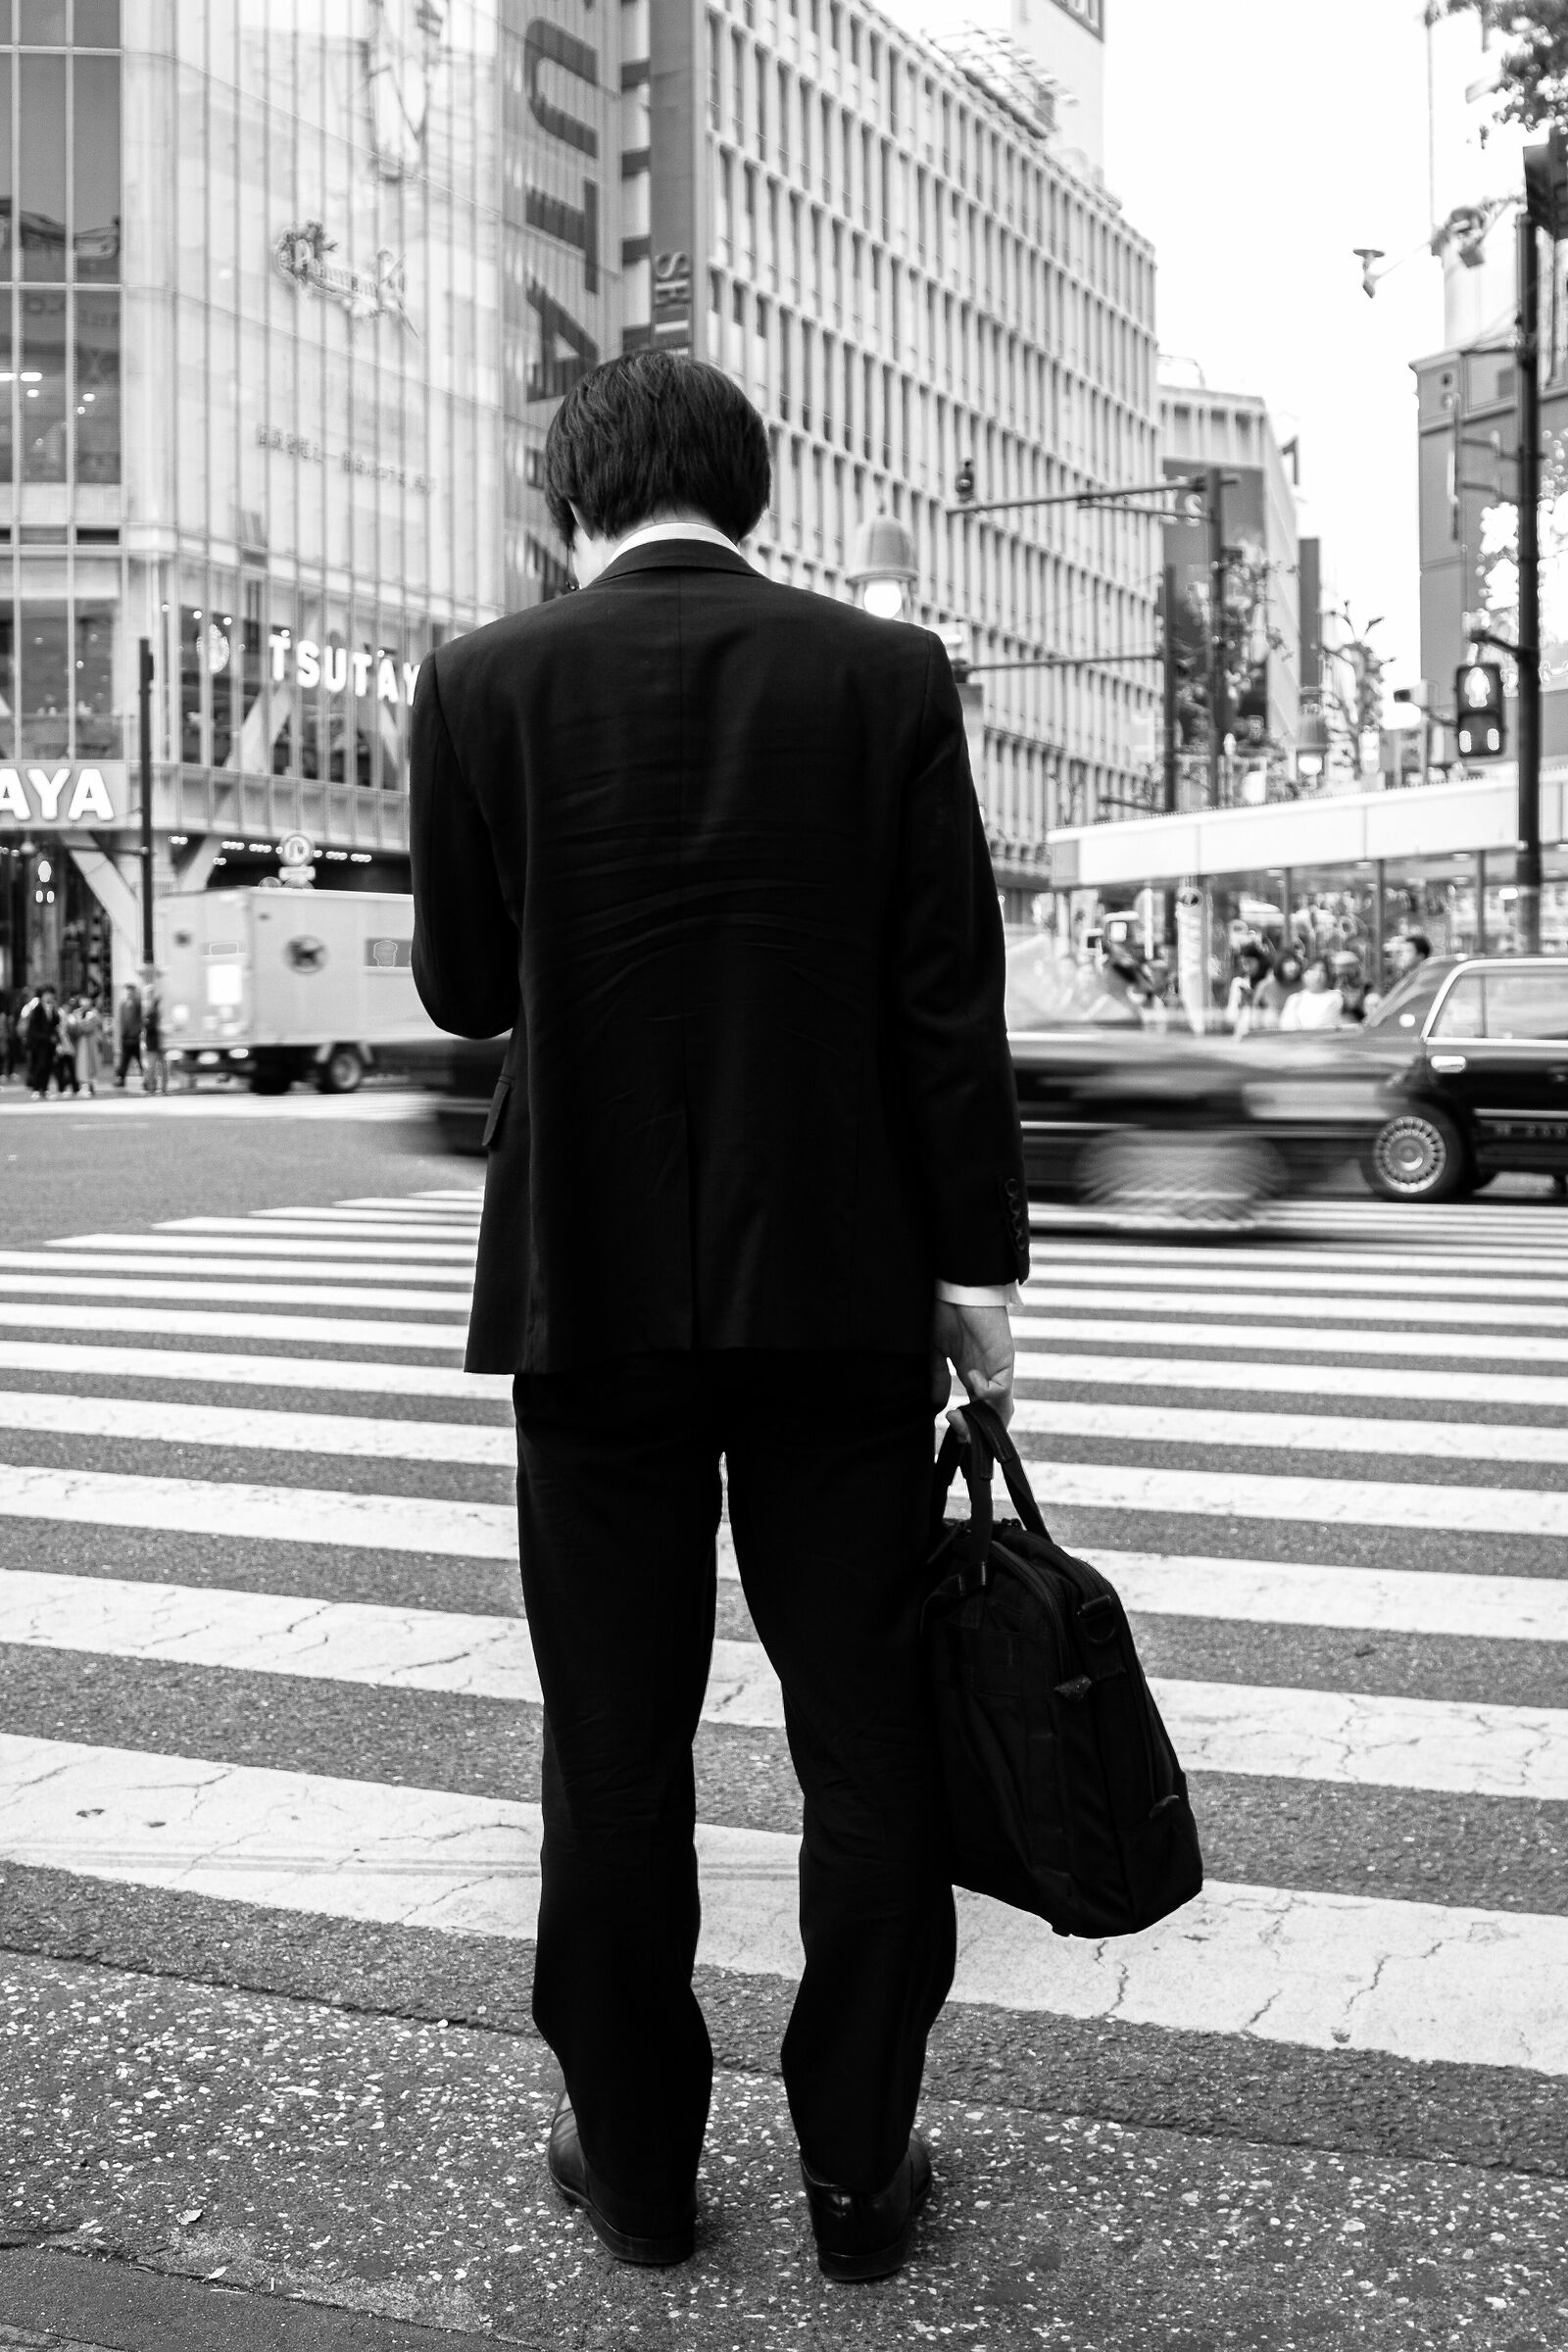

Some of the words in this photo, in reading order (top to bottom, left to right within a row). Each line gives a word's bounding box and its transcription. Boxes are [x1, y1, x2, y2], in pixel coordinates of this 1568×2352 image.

[654, 251, 689, 356] SEI
[269, 633, 421, 707] TSUTAY
[0, 767, 116, 821] AYA
